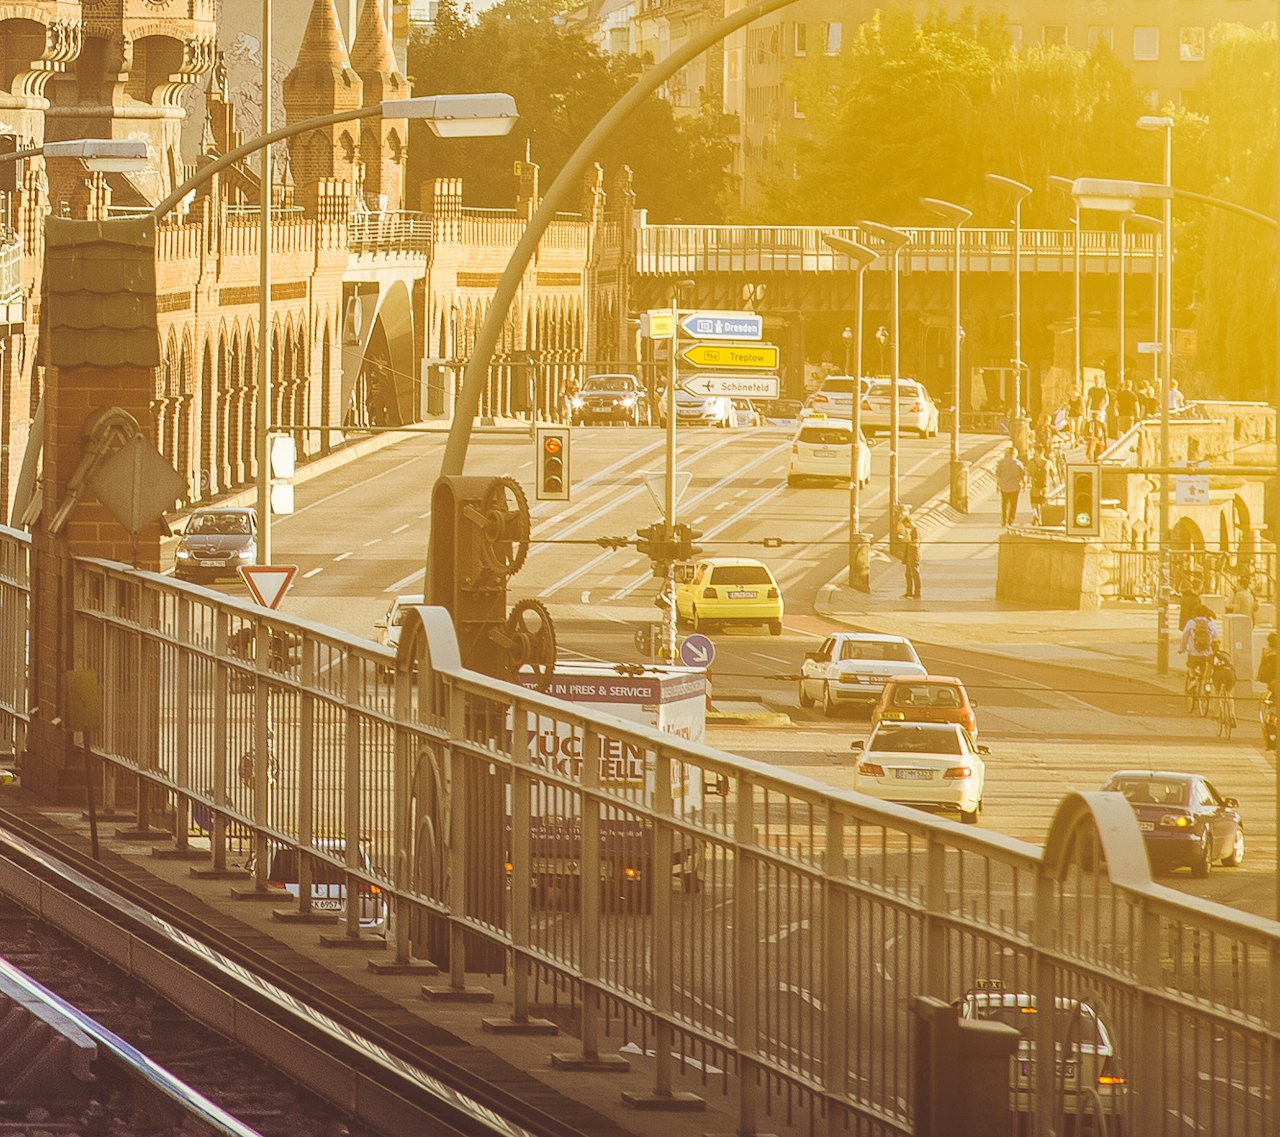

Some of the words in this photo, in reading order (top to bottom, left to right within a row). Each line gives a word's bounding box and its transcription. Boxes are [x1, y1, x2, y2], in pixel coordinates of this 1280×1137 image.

[724, 322, 758, 333] Dresden
[730, 352, 765, 363] Treptow
[555, 684, 567, 694] IN
[569, 685, 596, 695] PREIS
[598, 685, 607, 696] &
[609, 686, 652, 697] SERVICE!
